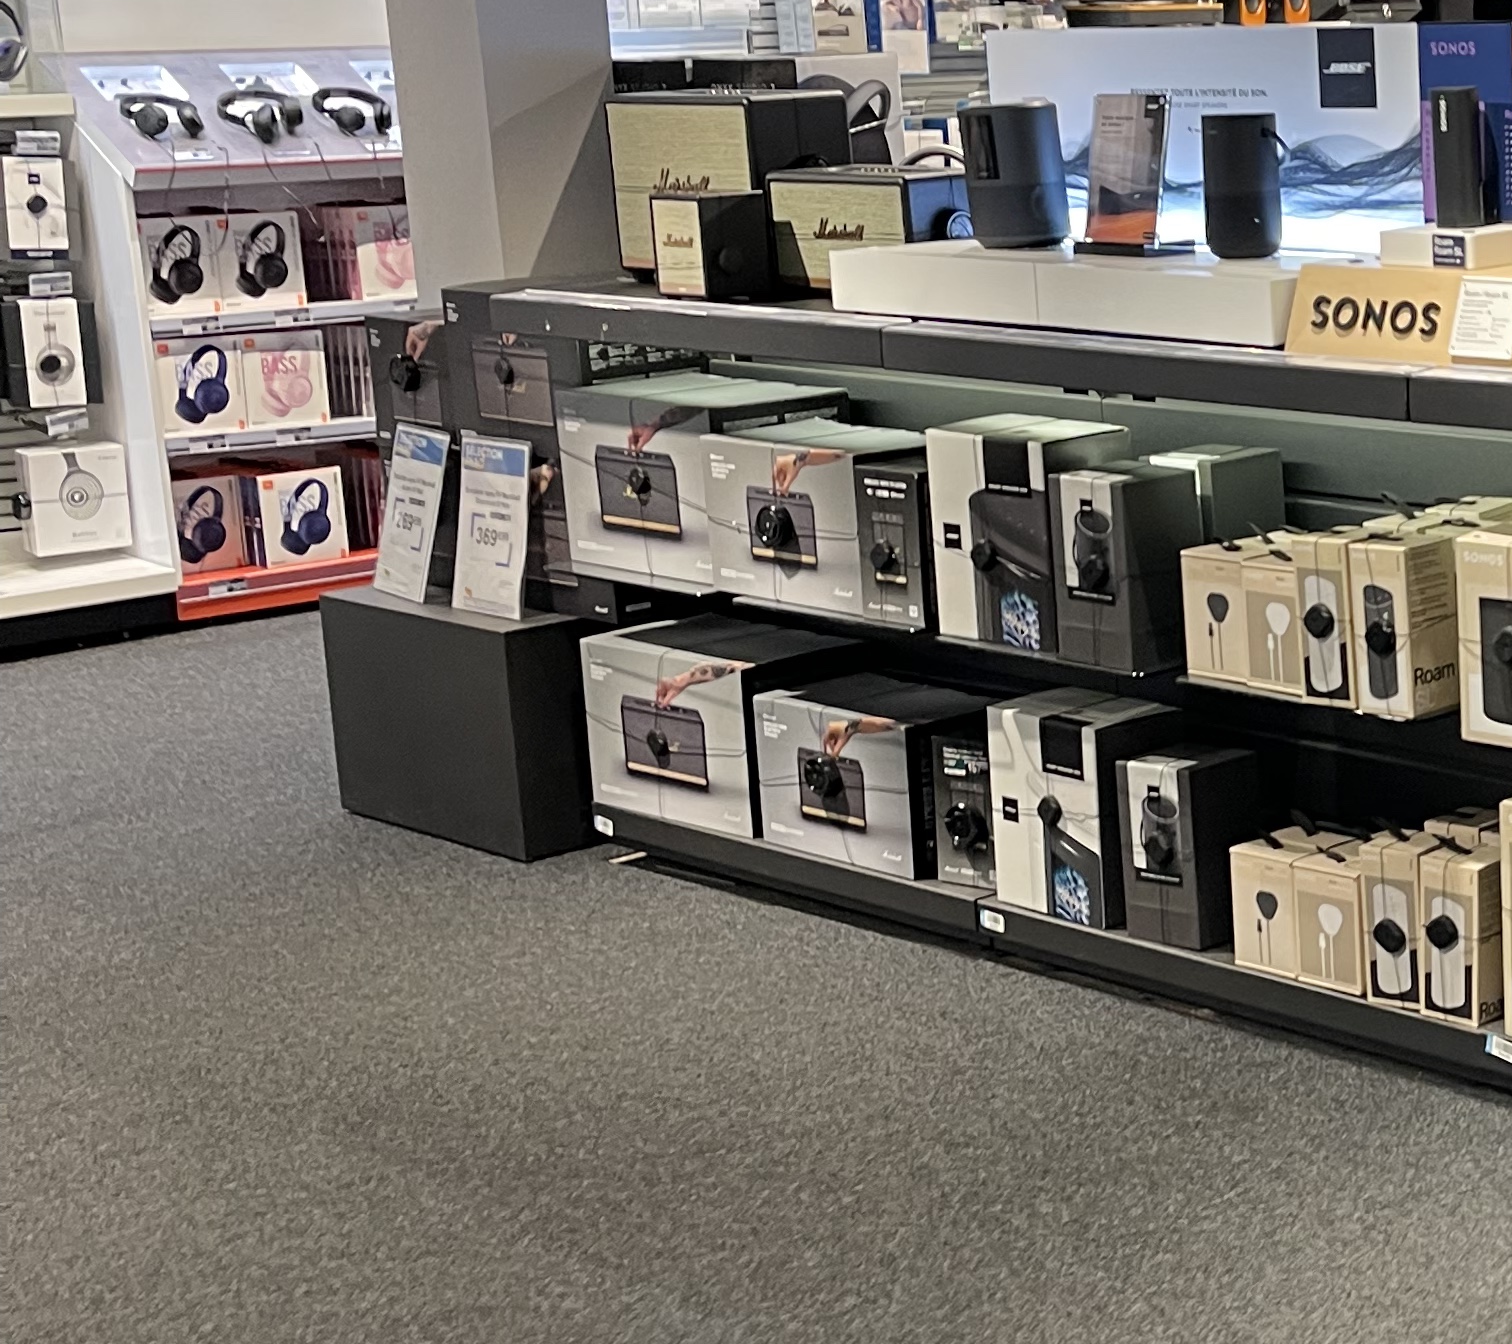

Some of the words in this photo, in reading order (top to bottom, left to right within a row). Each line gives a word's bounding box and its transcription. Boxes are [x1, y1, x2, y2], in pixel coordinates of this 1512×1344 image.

[1430, 40, 1477, 56] SONOS
[812, 216, 866, 242] Marshall
[1311, 294, 1443, 337] SONOS
[260, 355, 298, 377] BASS
[1463, 550, 1505, 567] SONOS
[1413, 661, 1456, 687] Roam
[1480, 1000, 1504, 1022] Ro
